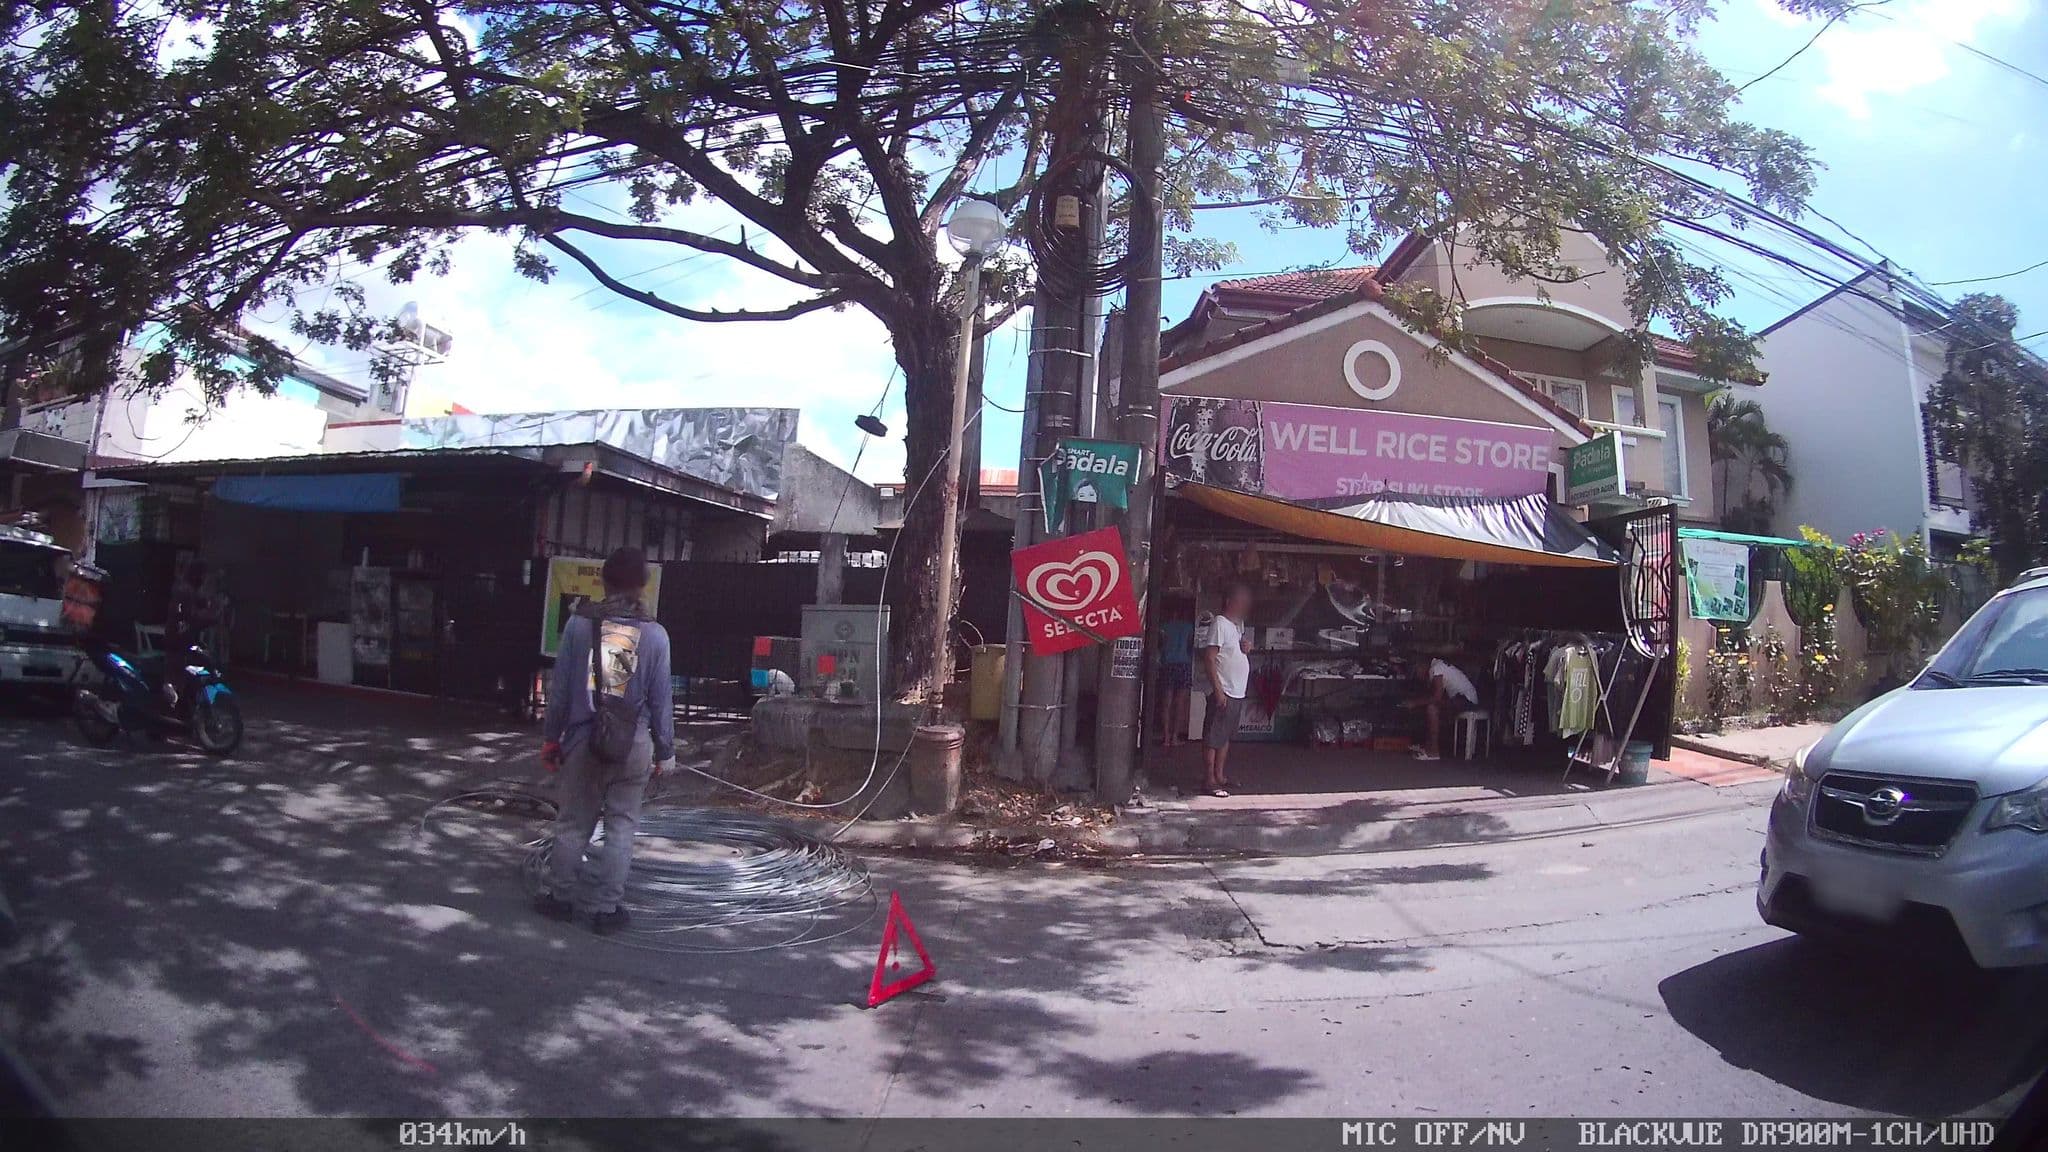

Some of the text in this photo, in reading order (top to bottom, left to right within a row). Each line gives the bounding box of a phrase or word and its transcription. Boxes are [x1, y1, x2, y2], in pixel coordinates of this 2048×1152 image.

[1067, 448, 1091, 457] SMART
[1170, 423, 1258, 461] Coca-Cola
[1269, 421, 1550, 472] WELL RICE STORE
[1052, 448, 1129, 476] Padala
[1044, 607, 1123, 638] SELECTA
